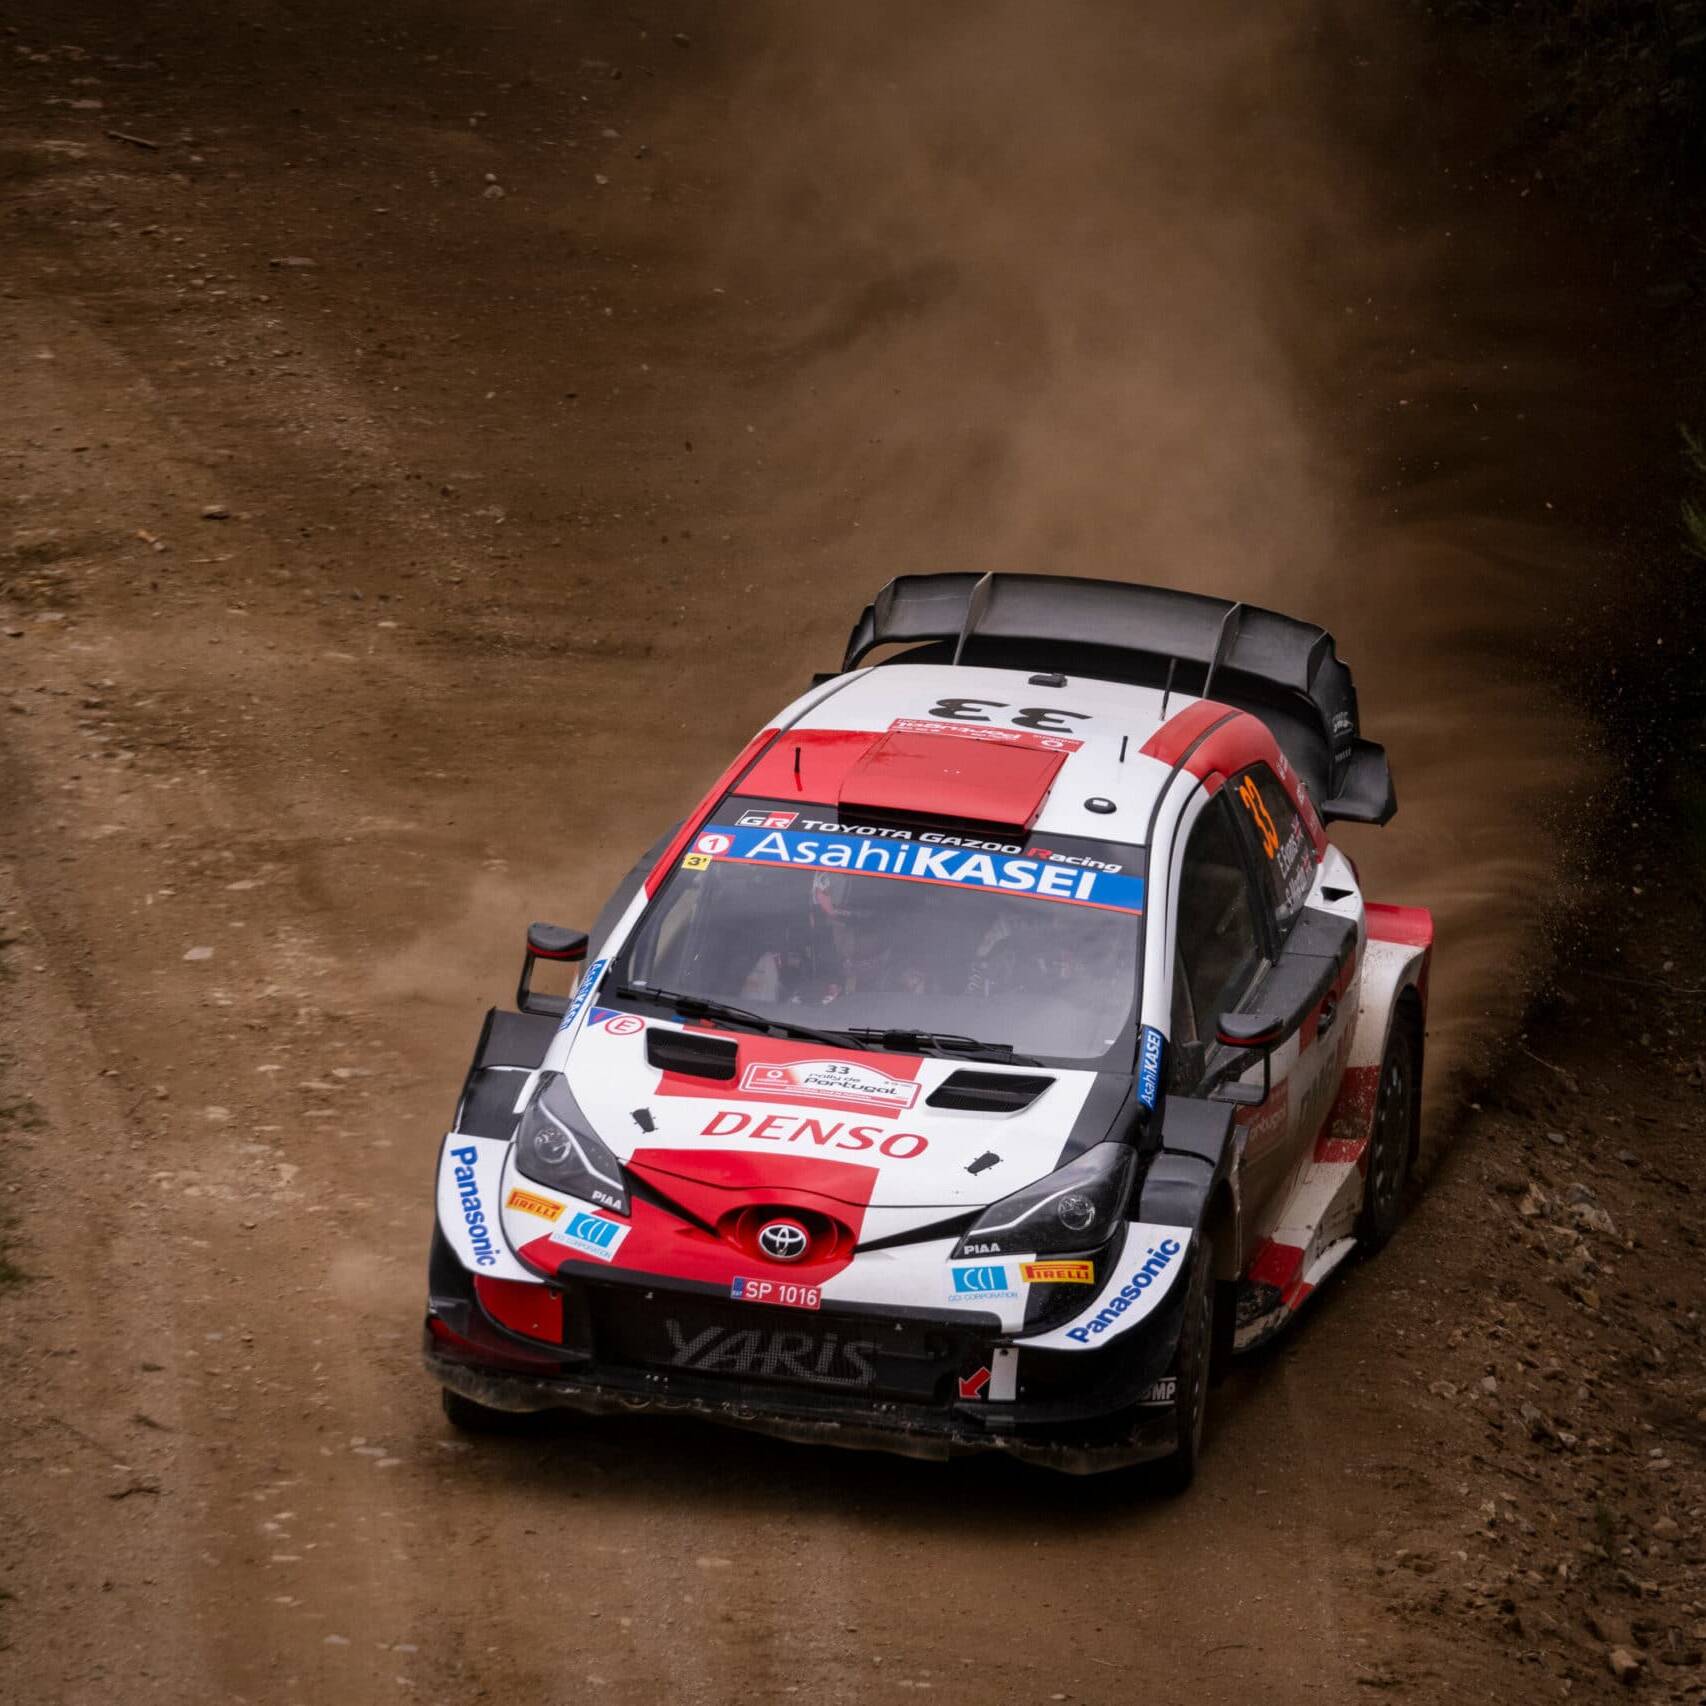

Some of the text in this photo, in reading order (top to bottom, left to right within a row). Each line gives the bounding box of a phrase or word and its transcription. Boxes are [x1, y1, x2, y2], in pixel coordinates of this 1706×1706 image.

[928, 698, 1093, 734] 33
[1239, 775, 1279, 859] 33
[708, 837, 720, 851] 1
[738, 815, 1123, 874] GR TOYOTA GAZOO Racing
[614, 1019, 636, 1032] E
[825, 1064, 850, 1075] 33
[699, 1111, 929, 1160] DENSO
[450, 1145, 500, 1267] Panasonic
[509, 1190, 562, 1218] PIRELLI
[592, 1190, 623, 1210] PIAA
[963, 1242, 1001, 1255] PIAA
[1025, 1264, 1089, 1280] PIRELLI
[745, 1281, 818, 1306] SP 1016
[1065, 1238, 1181, 1343] Panasonic
